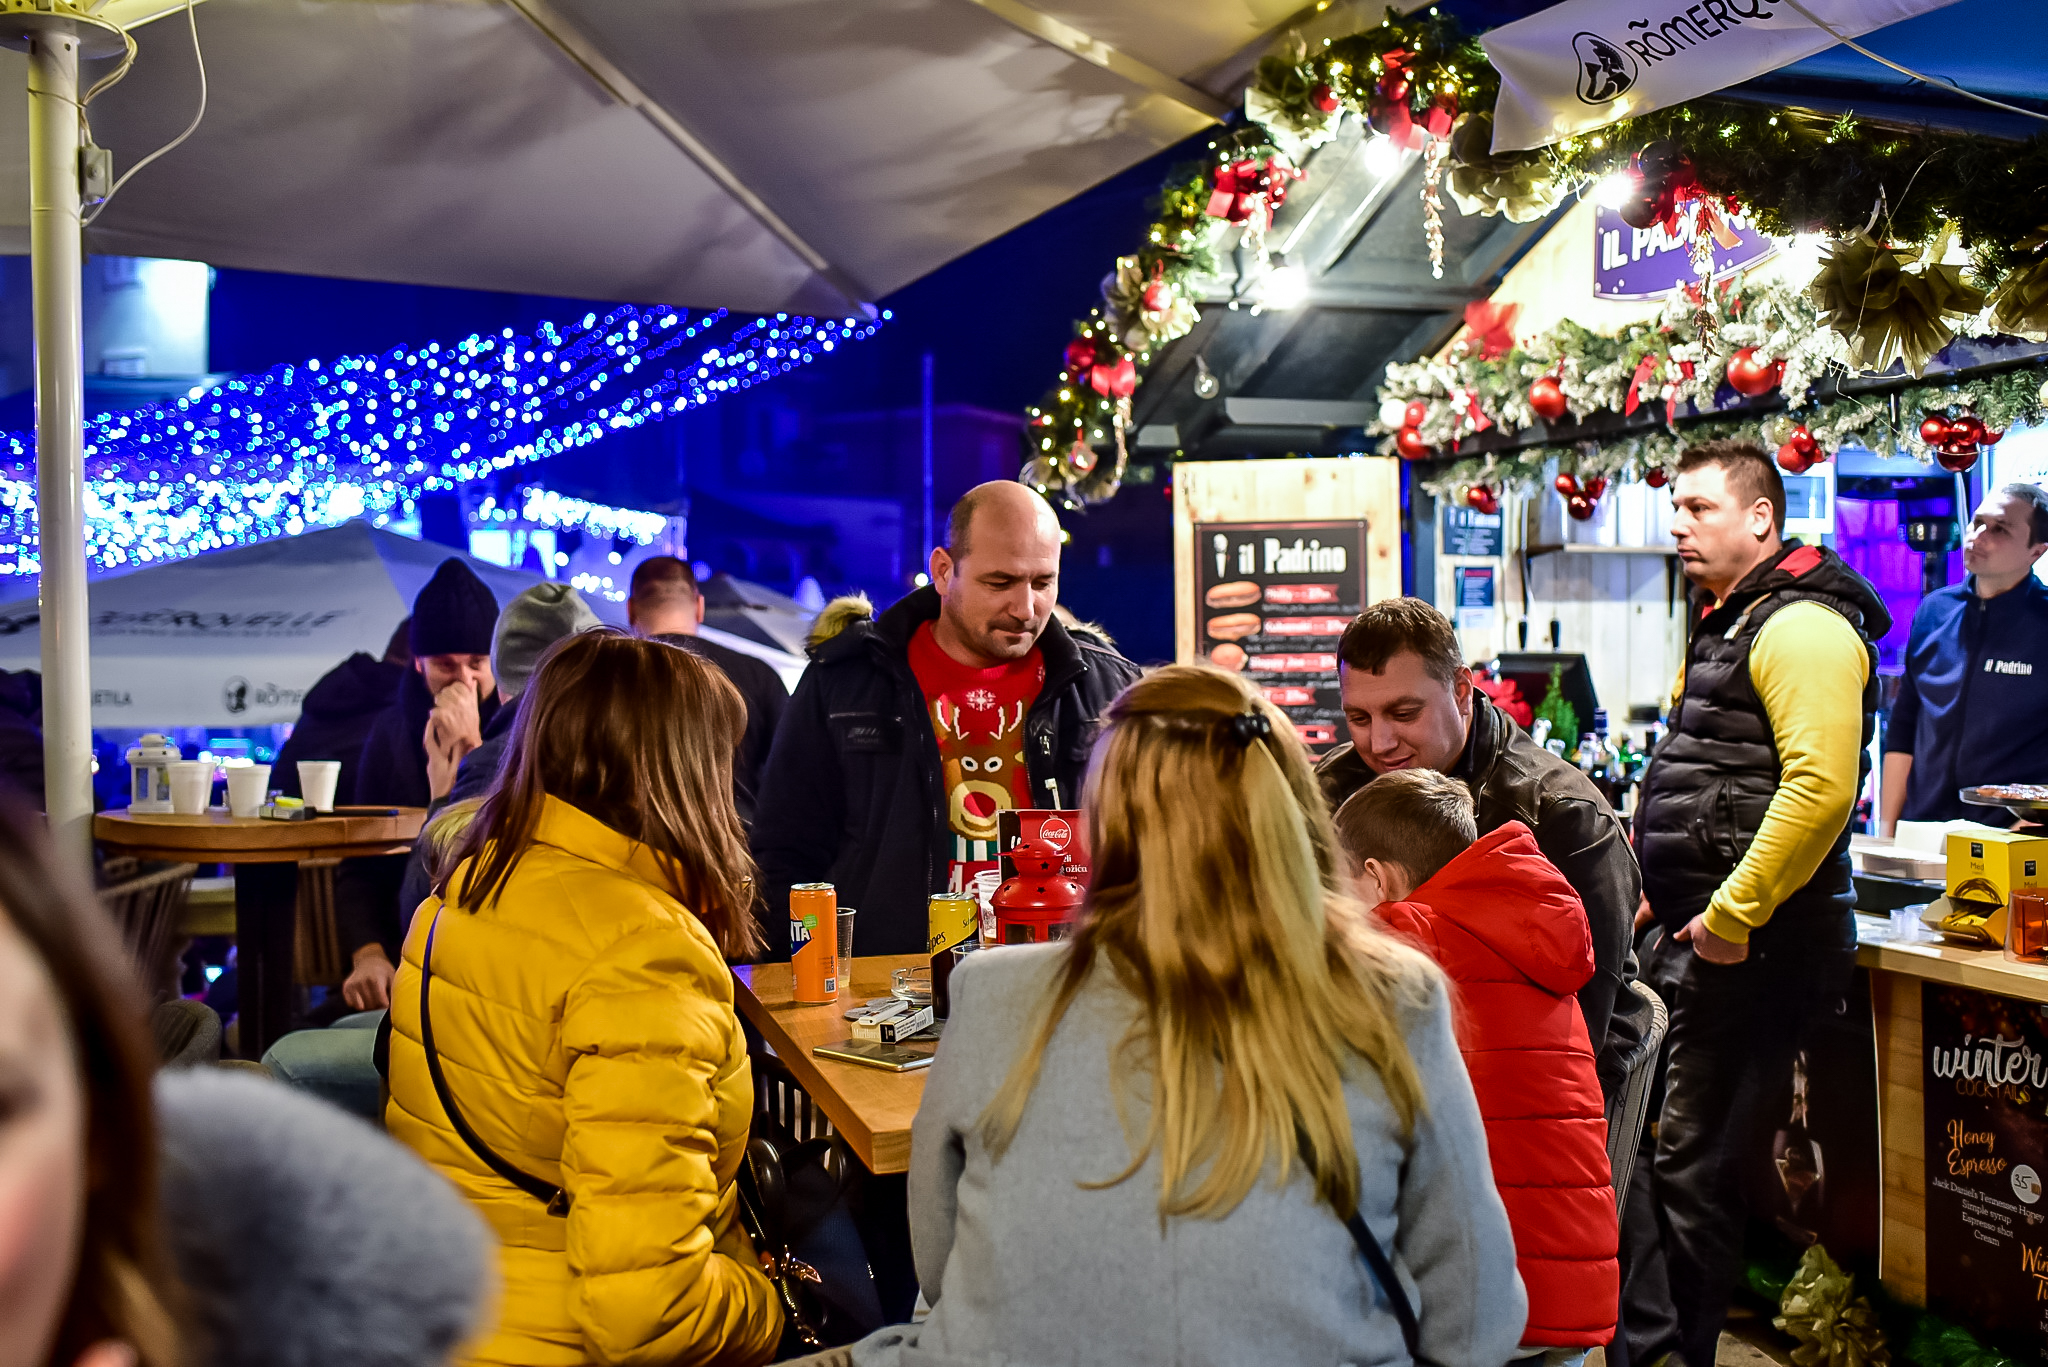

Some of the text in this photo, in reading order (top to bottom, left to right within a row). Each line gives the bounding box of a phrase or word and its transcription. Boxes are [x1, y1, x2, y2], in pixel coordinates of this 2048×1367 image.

[1603, 228, 1628, 271] IL
[1238, 537, 1347, 575] il Padrino
[1995, 660, 2033, 676] Padrino
[1933, 1033, 2048, 1089] winter
[1955, 1078, 2031, 1103] COCKTAILS
[1947, 1119, 1996, 1153] Honey
[1947, 1148, 2007, 1178] Espresso
[1932, 1176, 1950, 1190] Jack
[1979, 1191, 2018, 1213] Tennessee
[2018, 1204, 2045, 1223] Honey
[1961, 1199, 2012, 1226] Simple syrup
[1961, 1211, 2014, 1239] Espresso shot
[1973, 1229, 2000, 1247] Cream
